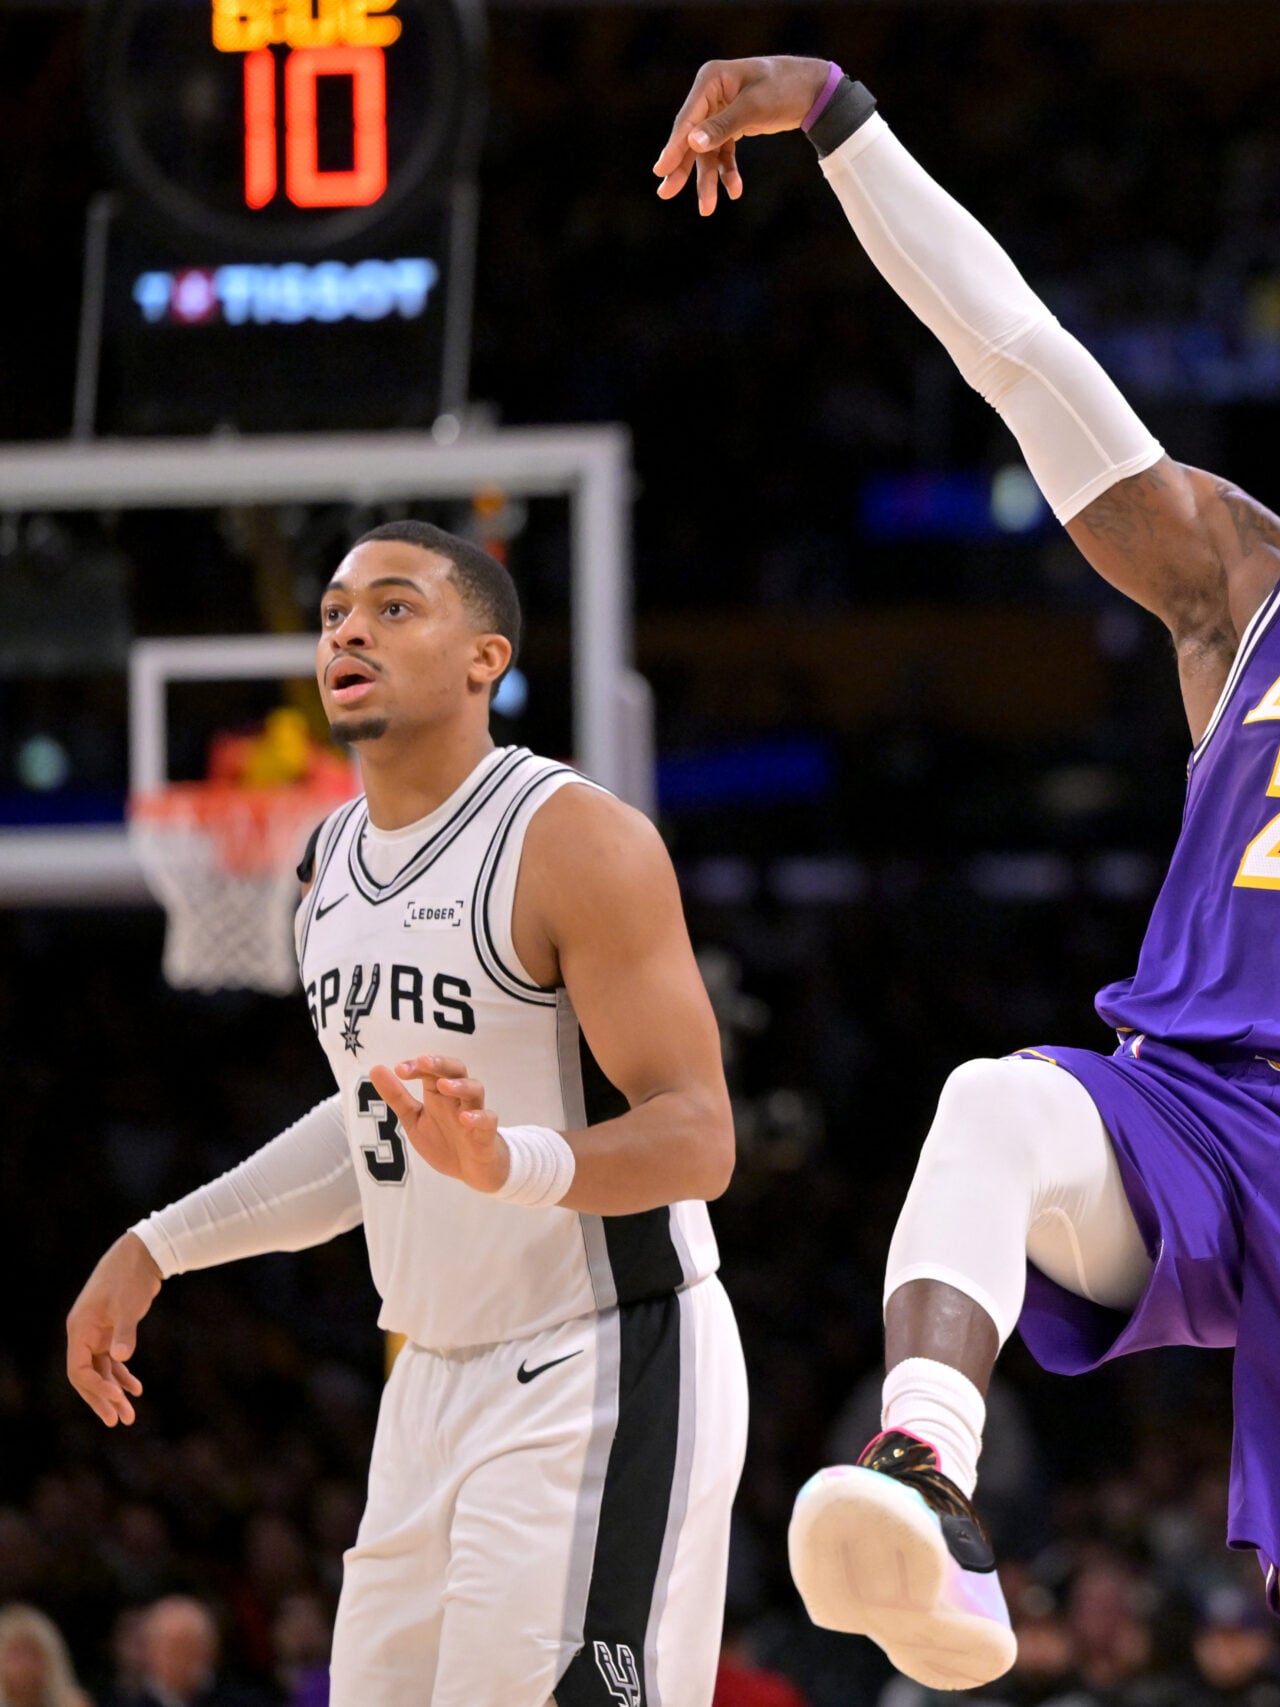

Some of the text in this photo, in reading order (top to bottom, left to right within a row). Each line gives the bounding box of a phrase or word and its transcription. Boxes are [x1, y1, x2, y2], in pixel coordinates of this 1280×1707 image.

[244, 46, 387, 210] 10
[411, 907, 455, 920] LEDGER
[355, 1076, 409, 1187] 3
